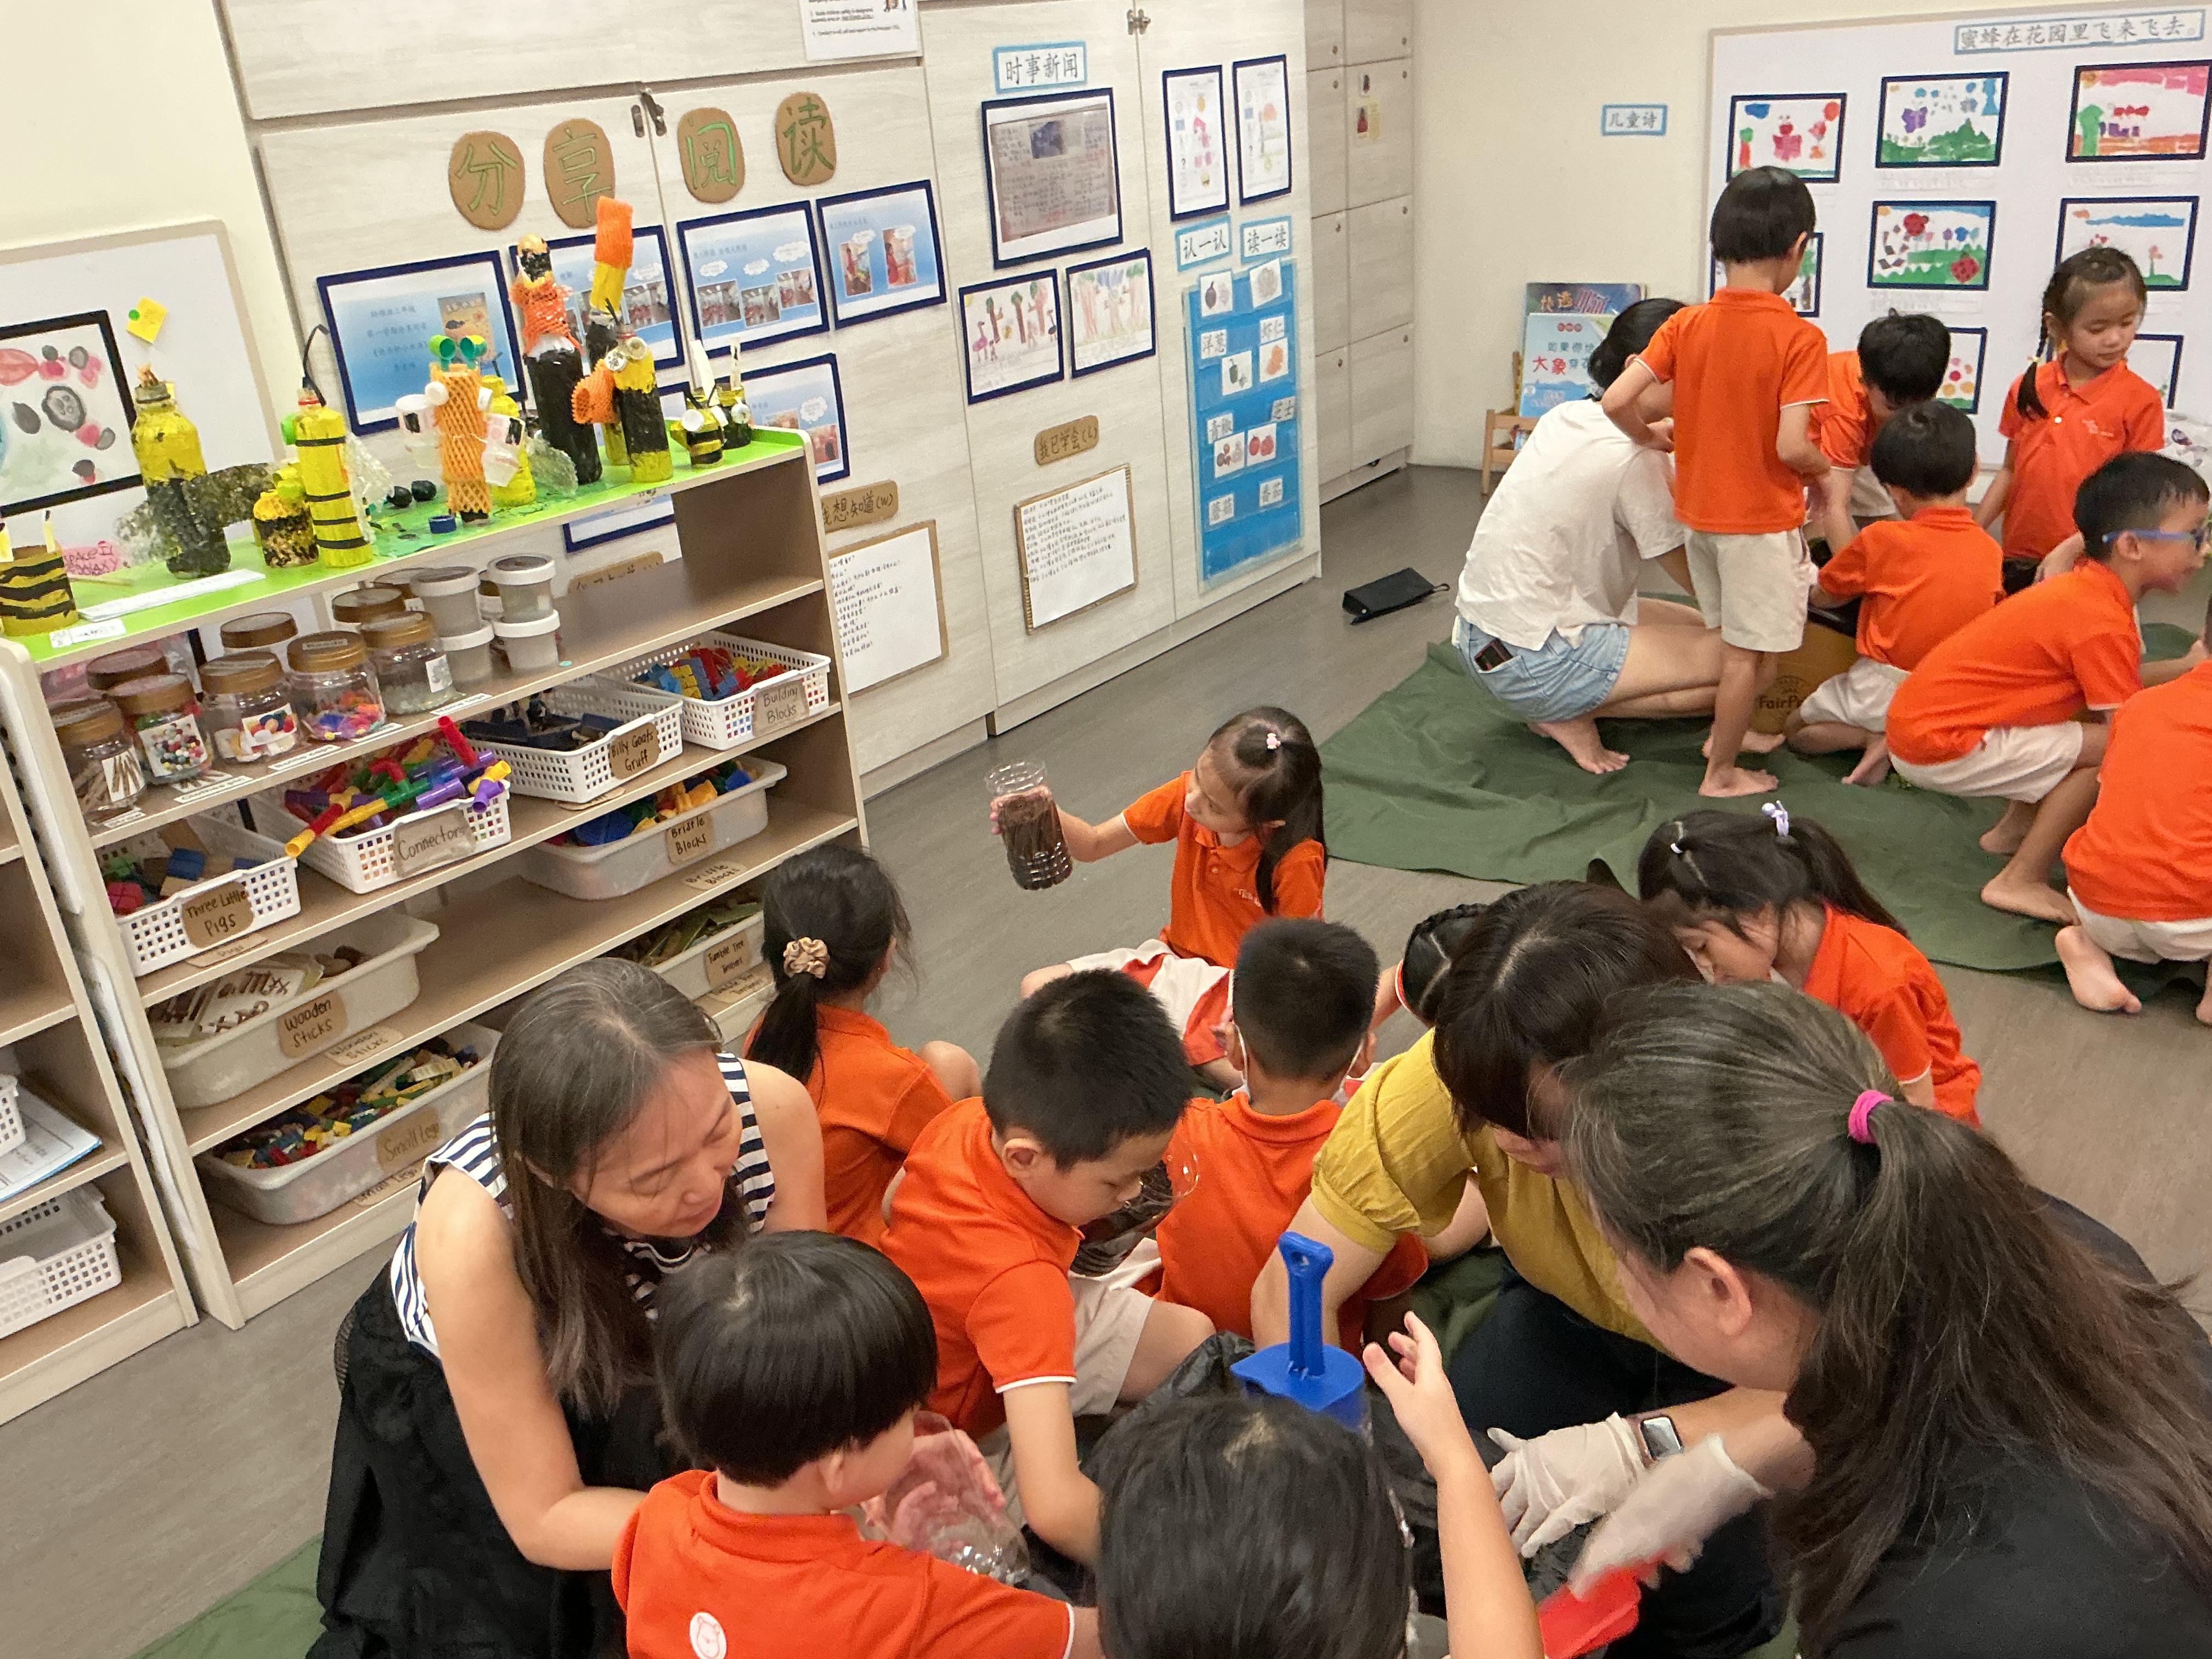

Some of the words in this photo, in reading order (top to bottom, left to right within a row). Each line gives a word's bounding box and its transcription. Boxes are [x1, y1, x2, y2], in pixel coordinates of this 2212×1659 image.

[1006, 52, 1079, 84] 时事新闻
[1609, 110, 1657, 128] 儿童诗
[1183, 229, 1227, 260] 认一认
[1247, 225, 1287, 253] 读一读
[763, 686, 798, 707] Building
[1758, 695, 1803, 709] FairPr
[767, 704, 797, 724] Blocks
[612, 740, 629, 758] Billy
[632, 728, 653, 748] Goats
[625, 749, 648, 772] Gruff
[671, 816, 705, 839] Bristle
[398, 825, 465, 861] Connectors
[675, 834, 706, 855] Blocks
[686, 865, 729, 883] Bristle
[704, 868, 740, 884] Blocks
[185, 898, 217, 919] Three
[219, 890, 247, 907] Little
[205, 913, 236, 937] Pigs
[284, 1000, 331, 1031] Wooden
[294, 1019, 332, 1048] Sticks
